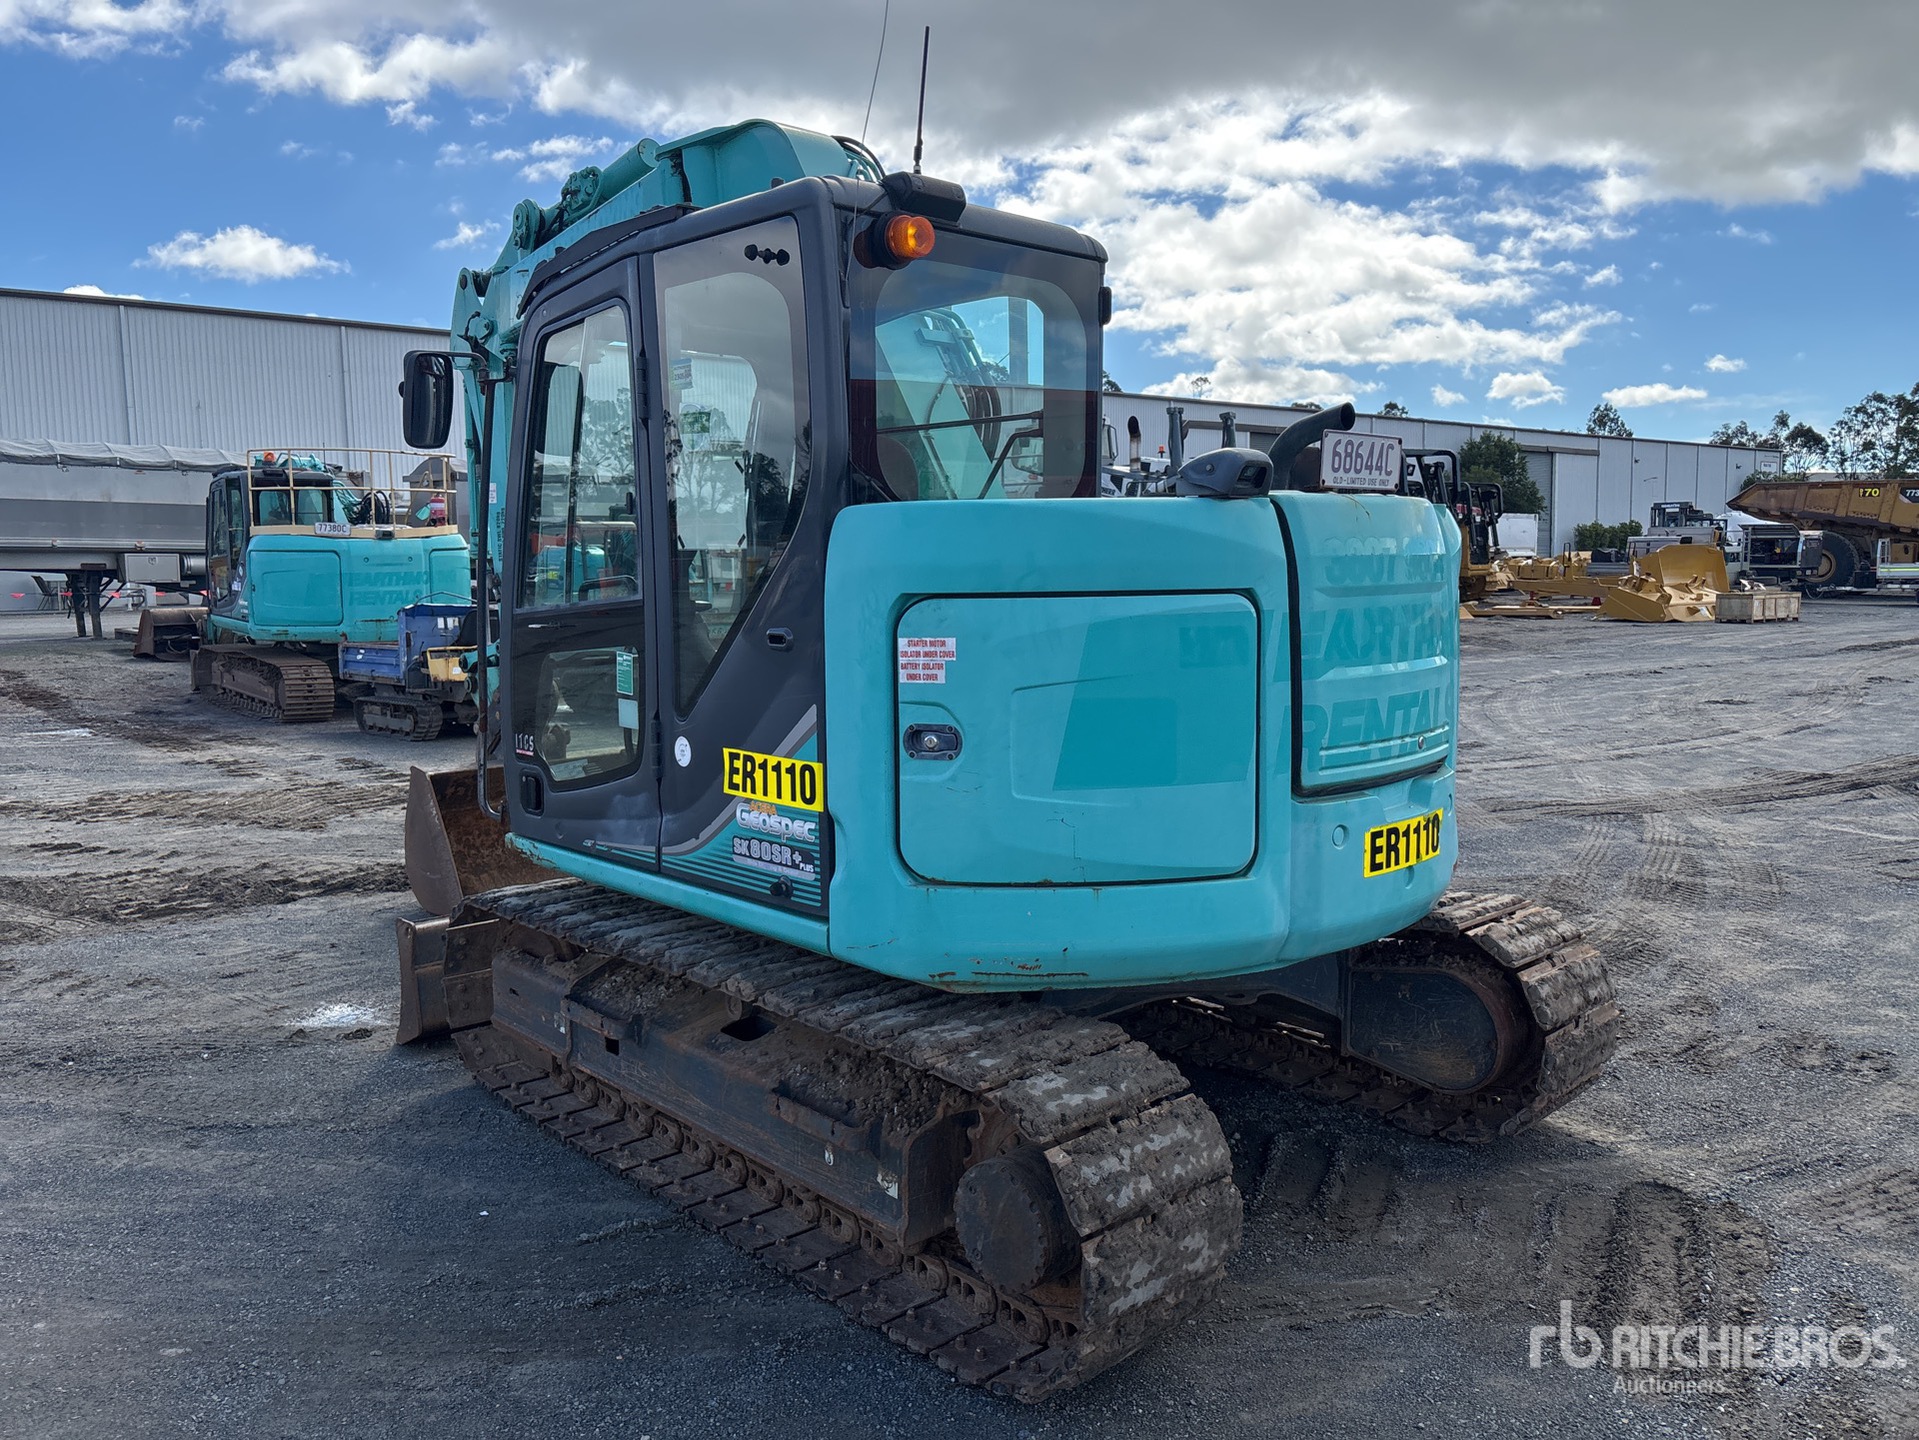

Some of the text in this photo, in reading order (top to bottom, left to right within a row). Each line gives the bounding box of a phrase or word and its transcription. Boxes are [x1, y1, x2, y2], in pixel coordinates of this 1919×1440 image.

[1331, 438, 1395, 477] 68644C
[1367, 478, 1377, 486] USE
[1864, 488, 1880, 497] 70
[318, 523, 347, 533] 77380C
[907, 639, 946, 648] STARTER MOTOR
[900, 650, 955, 658] ISOLATOR UNDER COVER
[900, 662, 944, 670] BATTERY ISOLATOR
[906, 673, 938, 681] UNDER COVER
[728, 752, 816, 806] ER1110
[749, 800, 777, 815] ACERA
[1370, 813, 1440, 873] ER1110
[800, 863, 814, 873] PLUS
